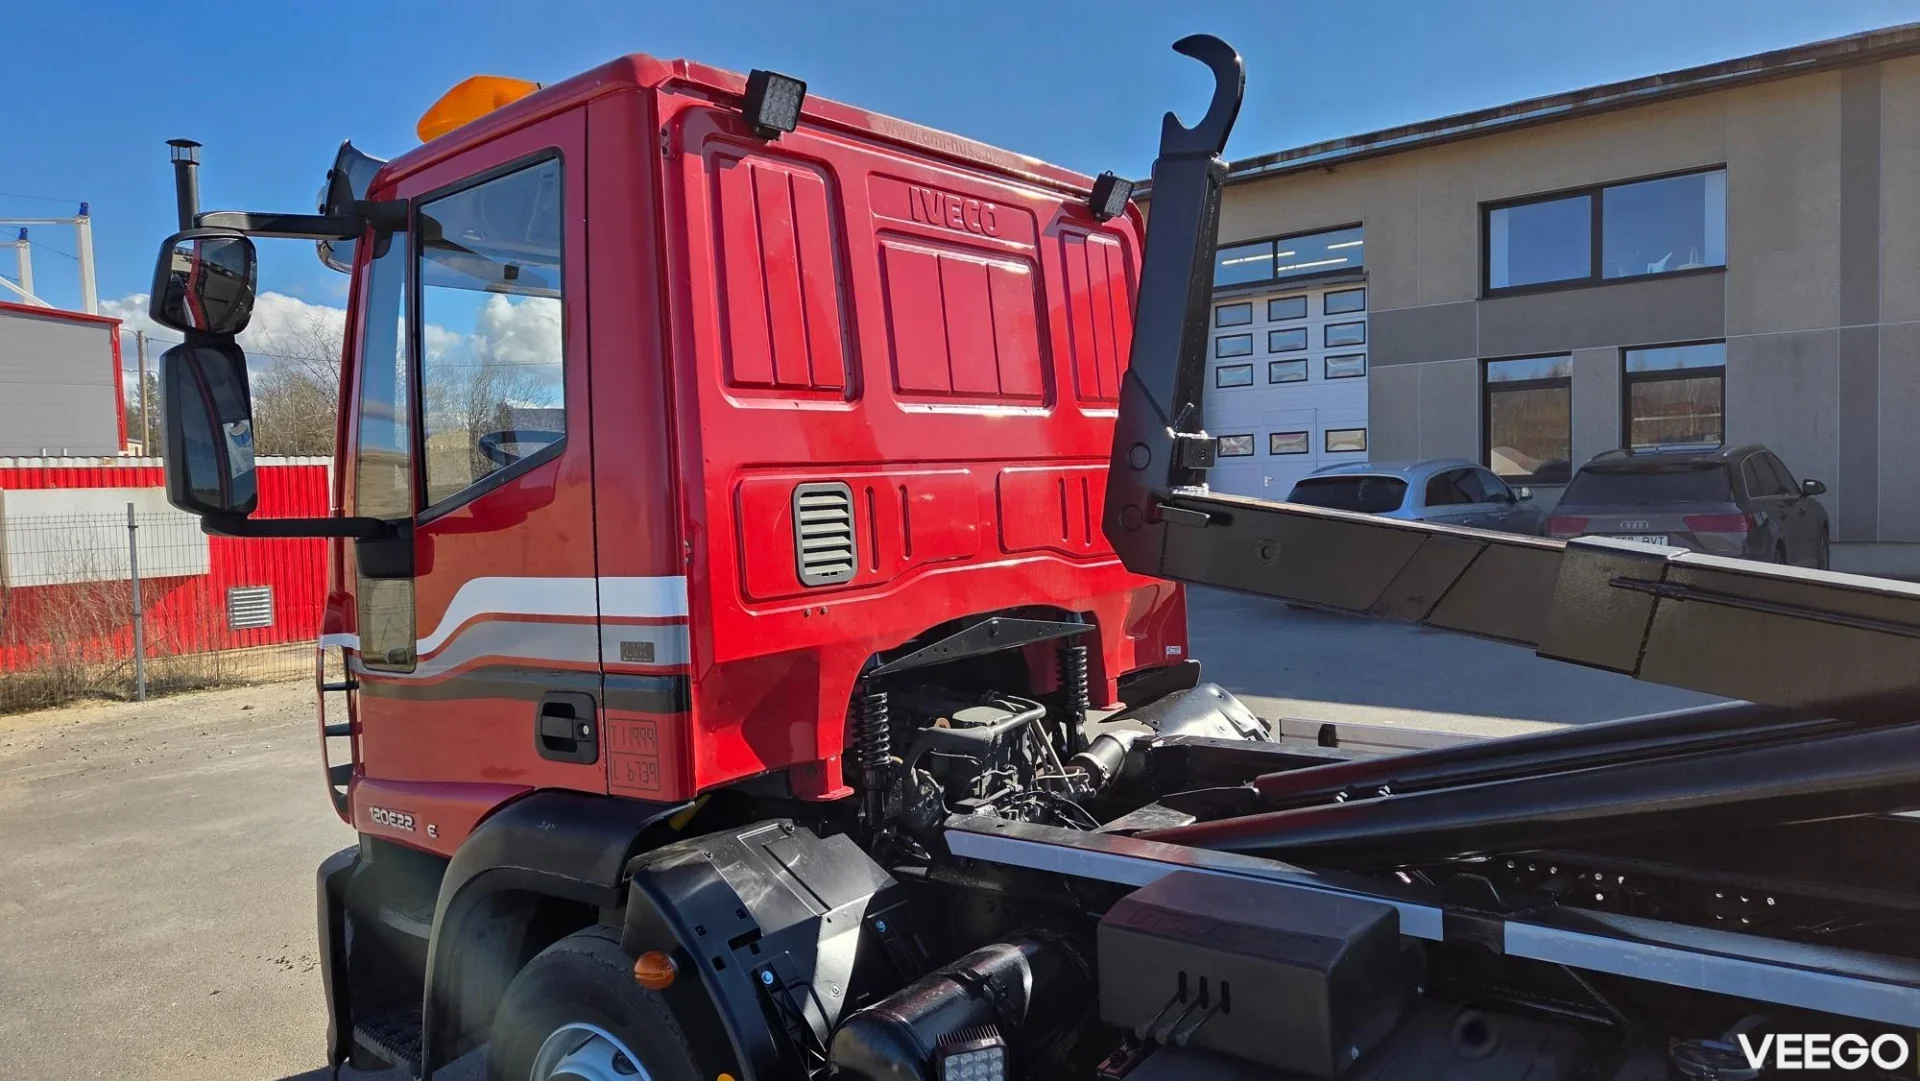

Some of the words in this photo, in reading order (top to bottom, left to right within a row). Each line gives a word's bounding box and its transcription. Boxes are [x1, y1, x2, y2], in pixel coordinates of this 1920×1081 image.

[908, 185, 1001, 237] IVECO
[627, 760, 658, 785] 6739
[369, 806, 415, 832] 120E22
